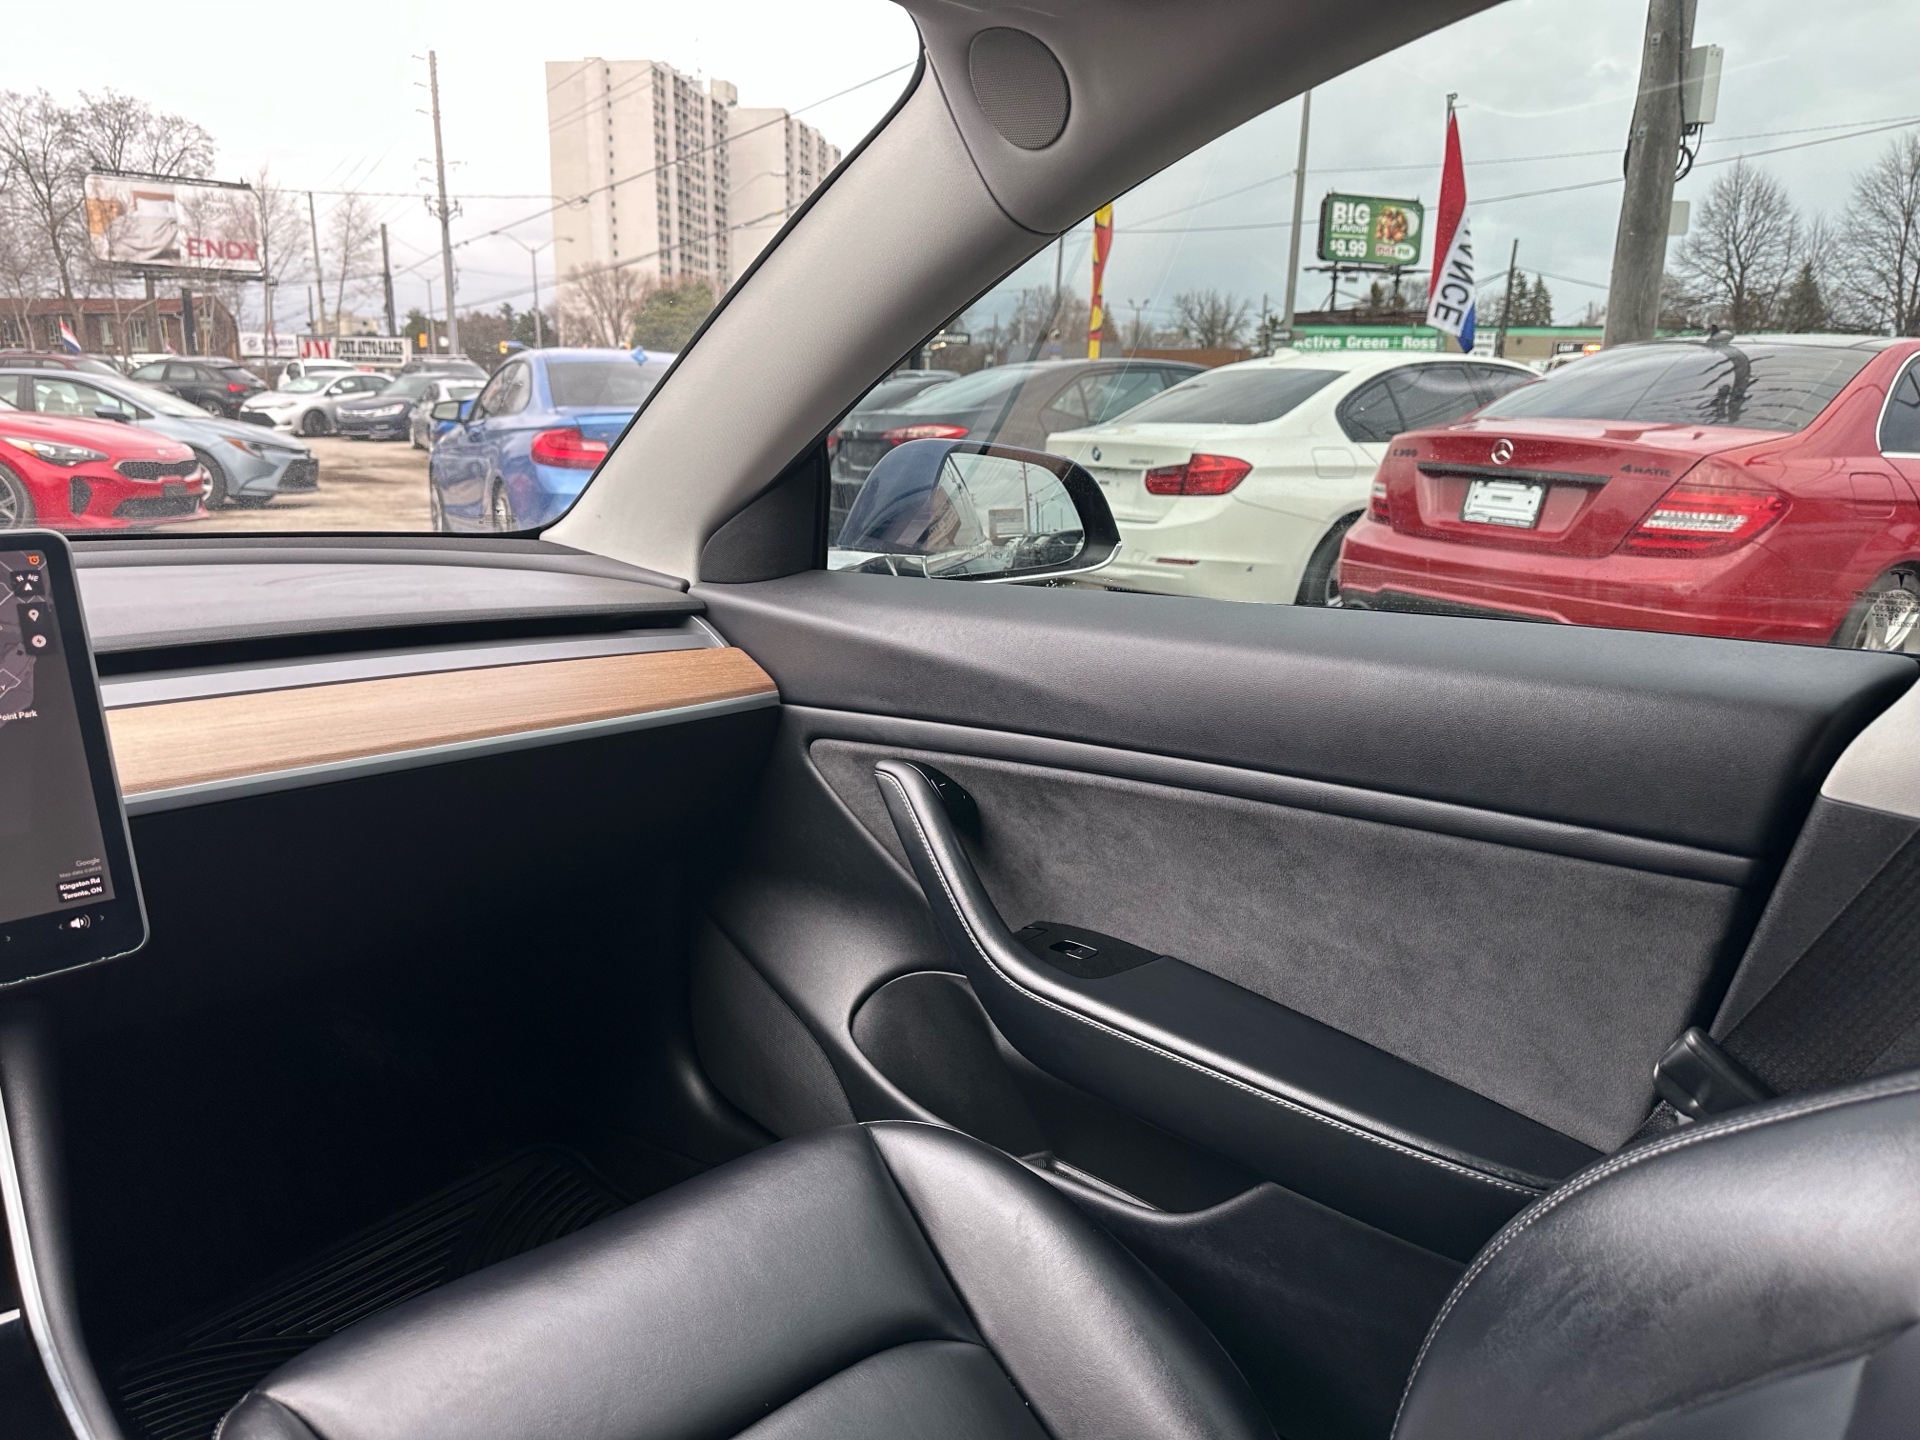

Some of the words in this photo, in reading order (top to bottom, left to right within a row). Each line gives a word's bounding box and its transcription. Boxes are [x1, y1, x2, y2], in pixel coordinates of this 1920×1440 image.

[1333, 201, 1370, 226] BIG
[1331, 223, 1369, 234] FLAVOUR
[187, 238, 258, 260] ENDY
[1330, 239, 1367, 258] $9.99
[1346, 335, 1389, 349] Green
[1402, 336, 1437, 349] Ross
[301, 339, 330, 358] JM
[16, 574, 24, 582] N
[28, 574, 39, 582] NE
[19, 710, 37, 719] Park
[76, 857, 100, 867] Google
[60, 880, 90, 890] Kingston
[63, 890, 90, 899] Toronto,
